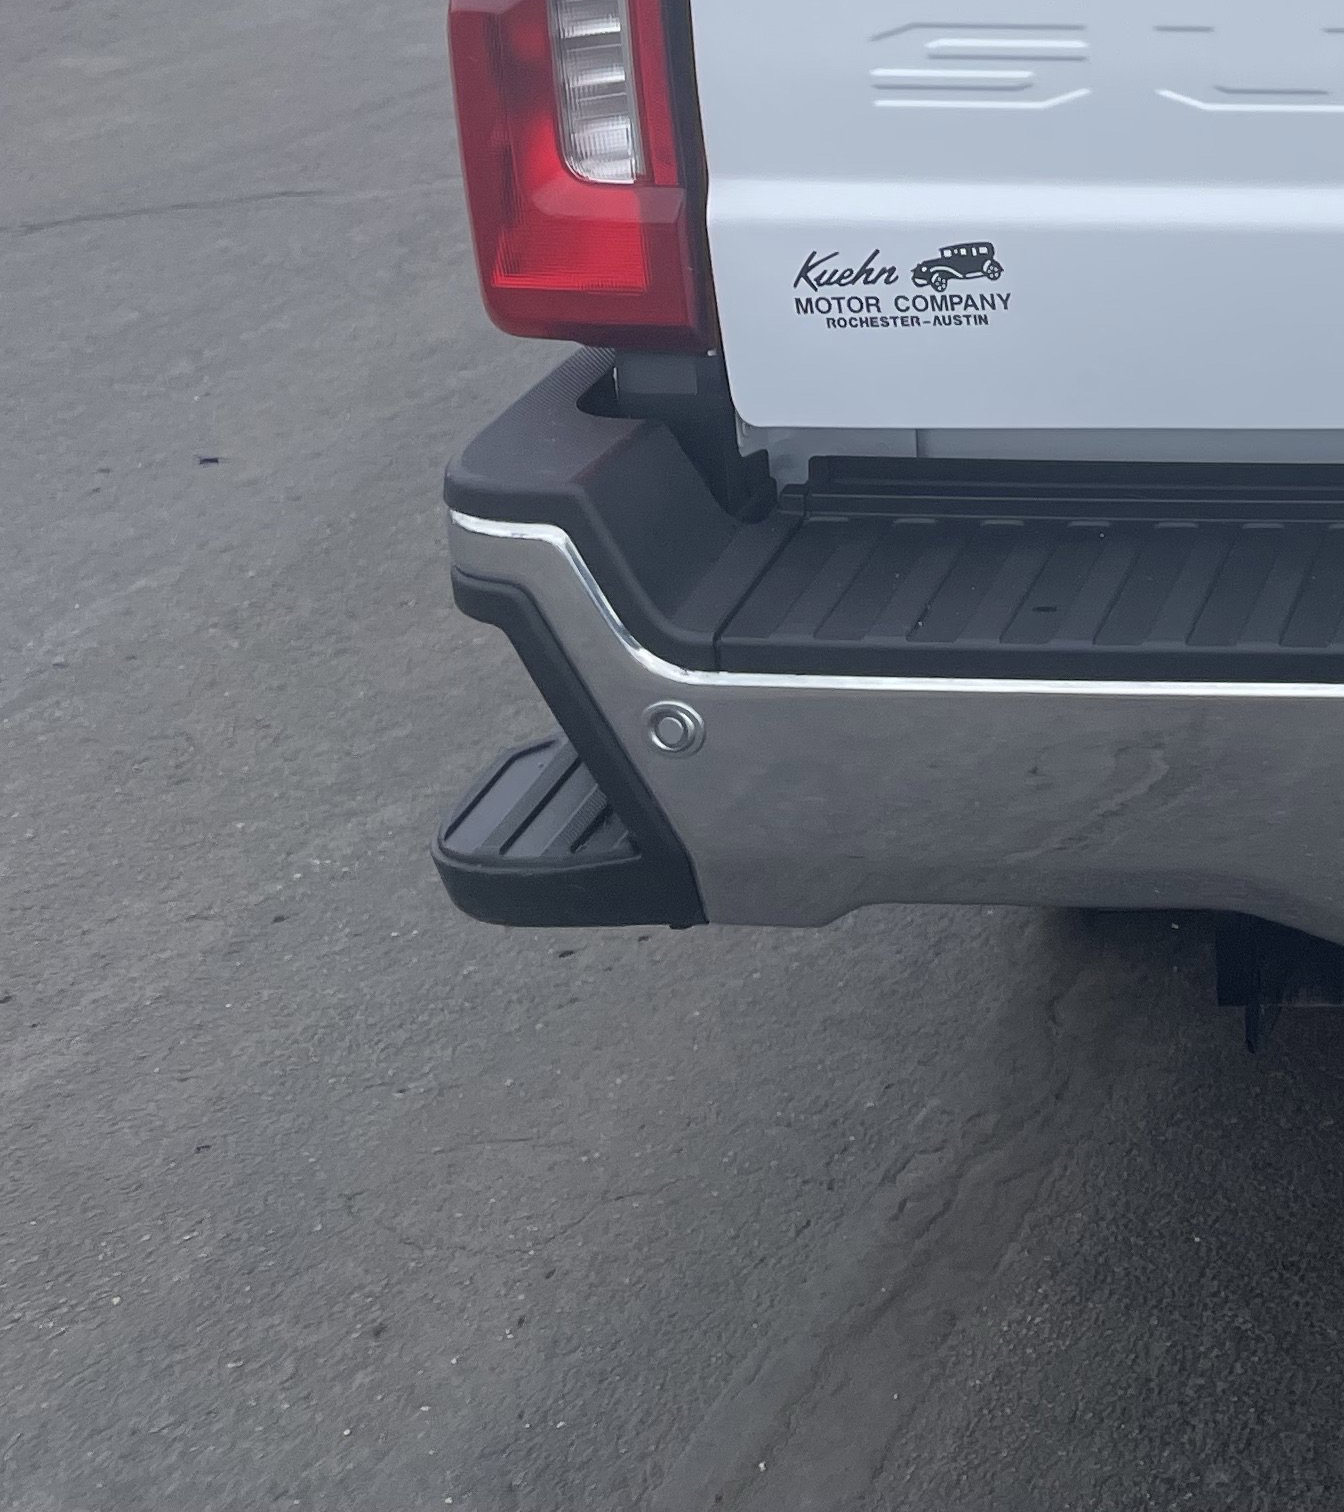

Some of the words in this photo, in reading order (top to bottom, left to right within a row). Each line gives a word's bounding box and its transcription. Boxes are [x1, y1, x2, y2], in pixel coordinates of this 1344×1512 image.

[793, 249, 899, 292] Kuehn
[794, 296, 882, 314] MOTOR
[894, 293, 1011, 312] COMPANY
